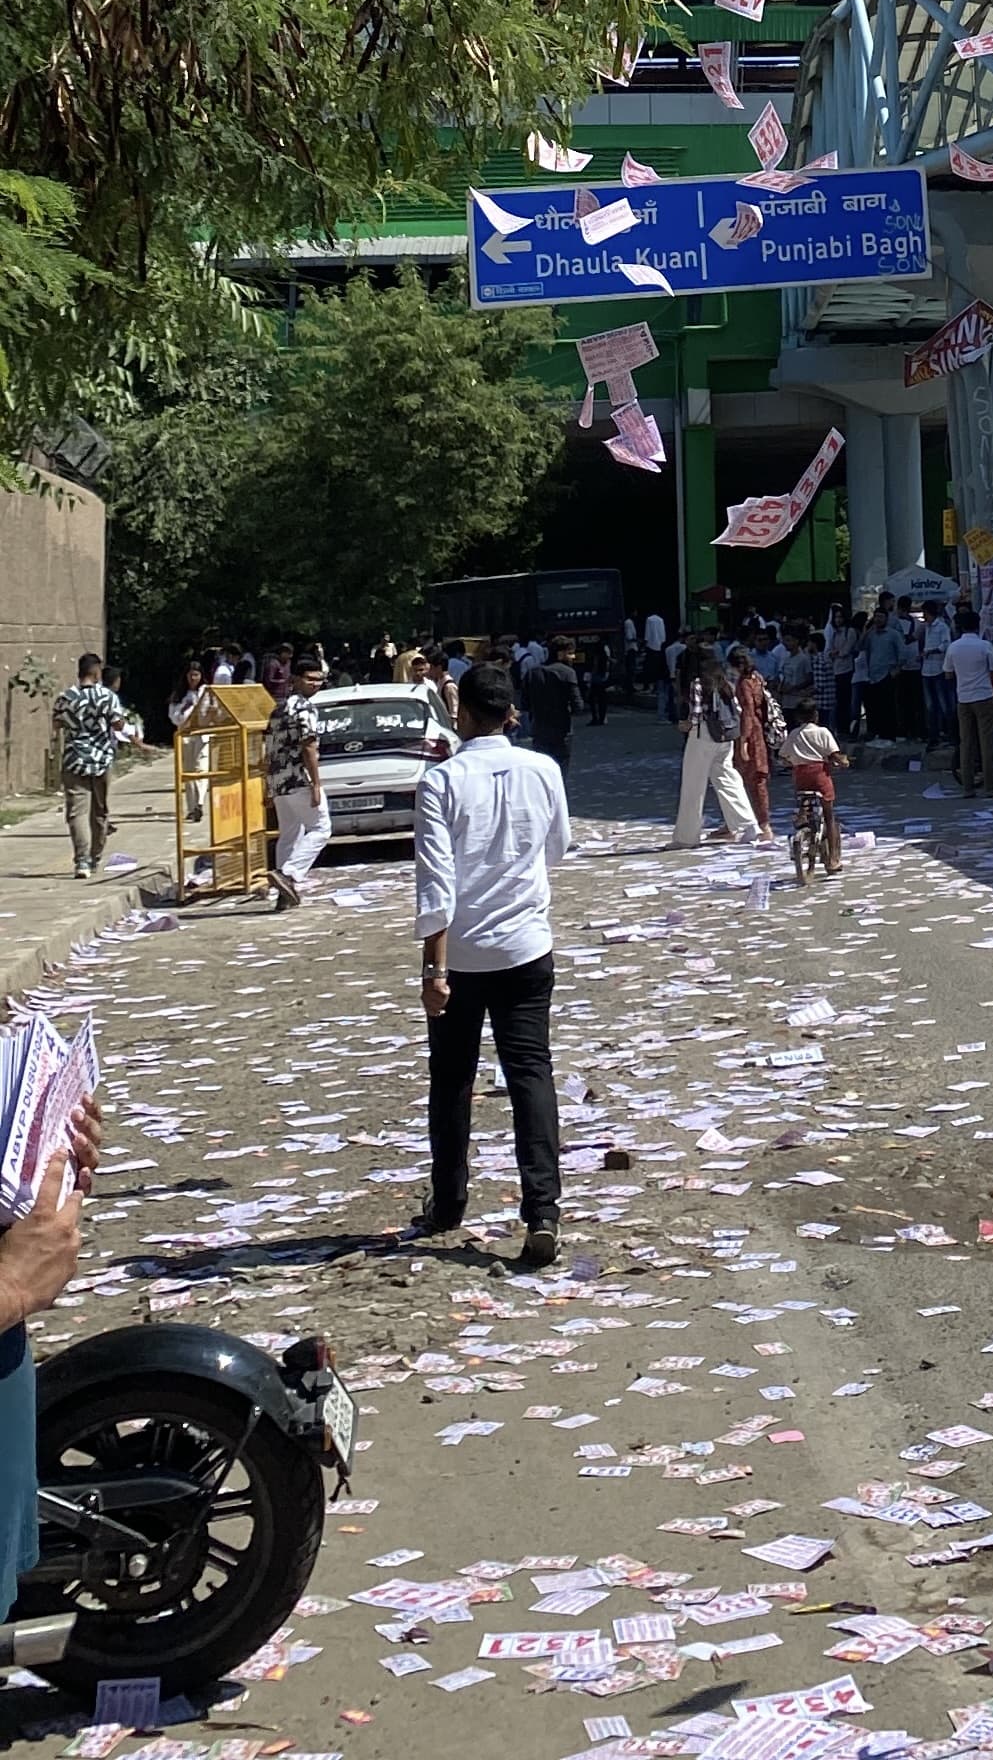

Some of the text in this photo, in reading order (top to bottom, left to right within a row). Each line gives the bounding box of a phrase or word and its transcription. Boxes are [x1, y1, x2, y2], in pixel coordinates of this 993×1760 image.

[759, 190, 887, 217] पंजाबी बाग
[536, 246, 699, 278] Dhaula Kuan
[762, 231, 922, 264] Punjabi Bagh
[911, 579, 943, 590] kinley
[9, 1109, 27, 1173] ABVP
[24, 1062, 38, 1108] DUSU
[488, 1636, 596, 1654] 4321
